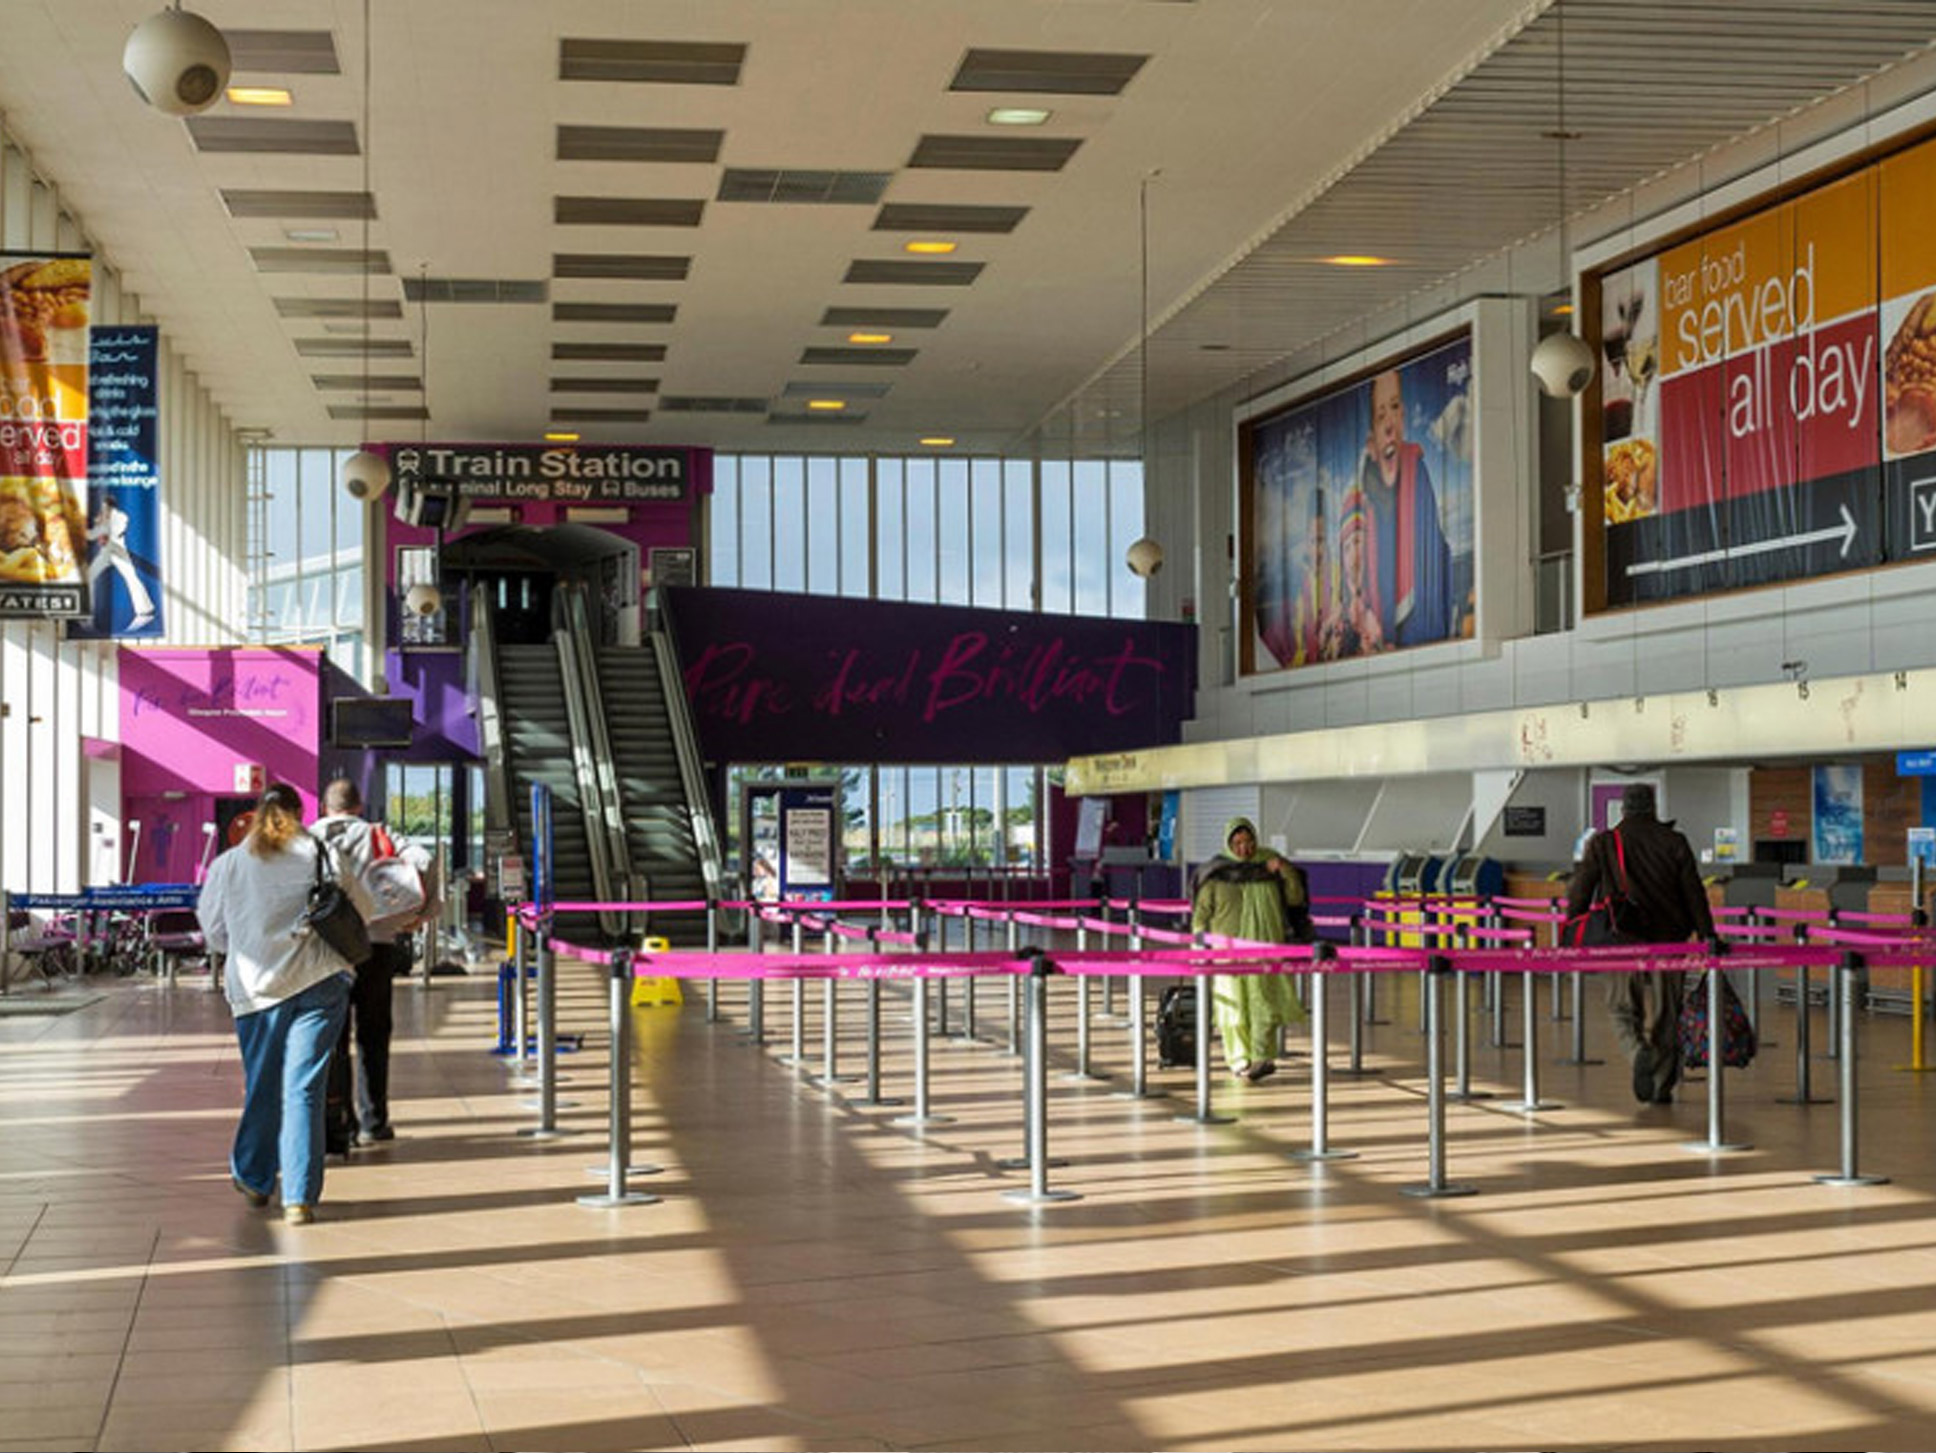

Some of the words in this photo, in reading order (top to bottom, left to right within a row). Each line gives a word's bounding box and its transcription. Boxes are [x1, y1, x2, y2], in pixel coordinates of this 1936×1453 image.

[1664, 271, 1696, 309] bar
[1701, 240, 1745, 295] food
[1677, 241, 1815, 371] served
[0, 388, 62, 419] ood
[1730, 345, 1773, 438] all
[1790, 331, 1873, 429] day
[0, 419, 81, 450] erved
[427, 449, 530, 476] Train
[539, 450, 681, 478] Station
[505, 480, 549, 498] Long
[554, 480, 592, 499] Stay
[624, 481, 681, 498] Buses
[922, 631, 1169, 722] Brilliant
